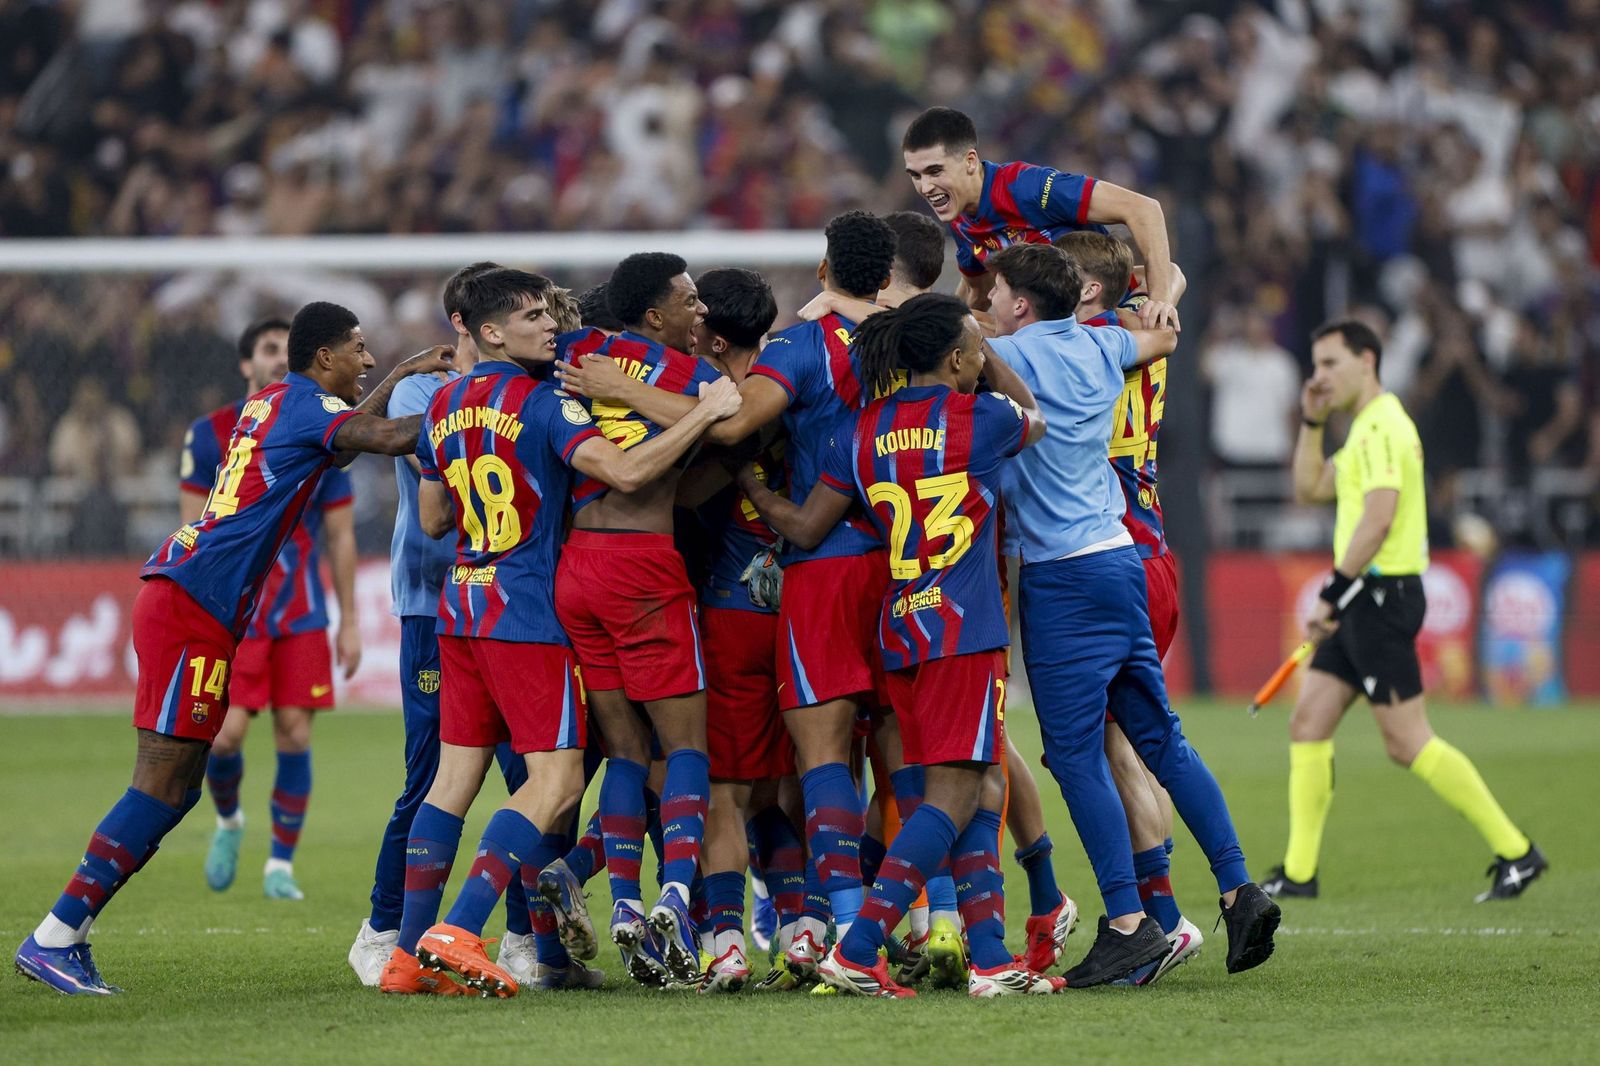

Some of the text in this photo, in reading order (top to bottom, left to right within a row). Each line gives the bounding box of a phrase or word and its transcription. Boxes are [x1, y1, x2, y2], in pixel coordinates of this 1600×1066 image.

[429, 406, 525, 450] GERARD MARTÍN
[874, 427, 945, 458] KOUNDE
[443, 453, 522, 553] 18
[865, 471, 975, 580] 23
[908, 594, 942, 611] ACNUR
[189, 655, 228, 701] 14
[995, 678, 1007, 721] 2
